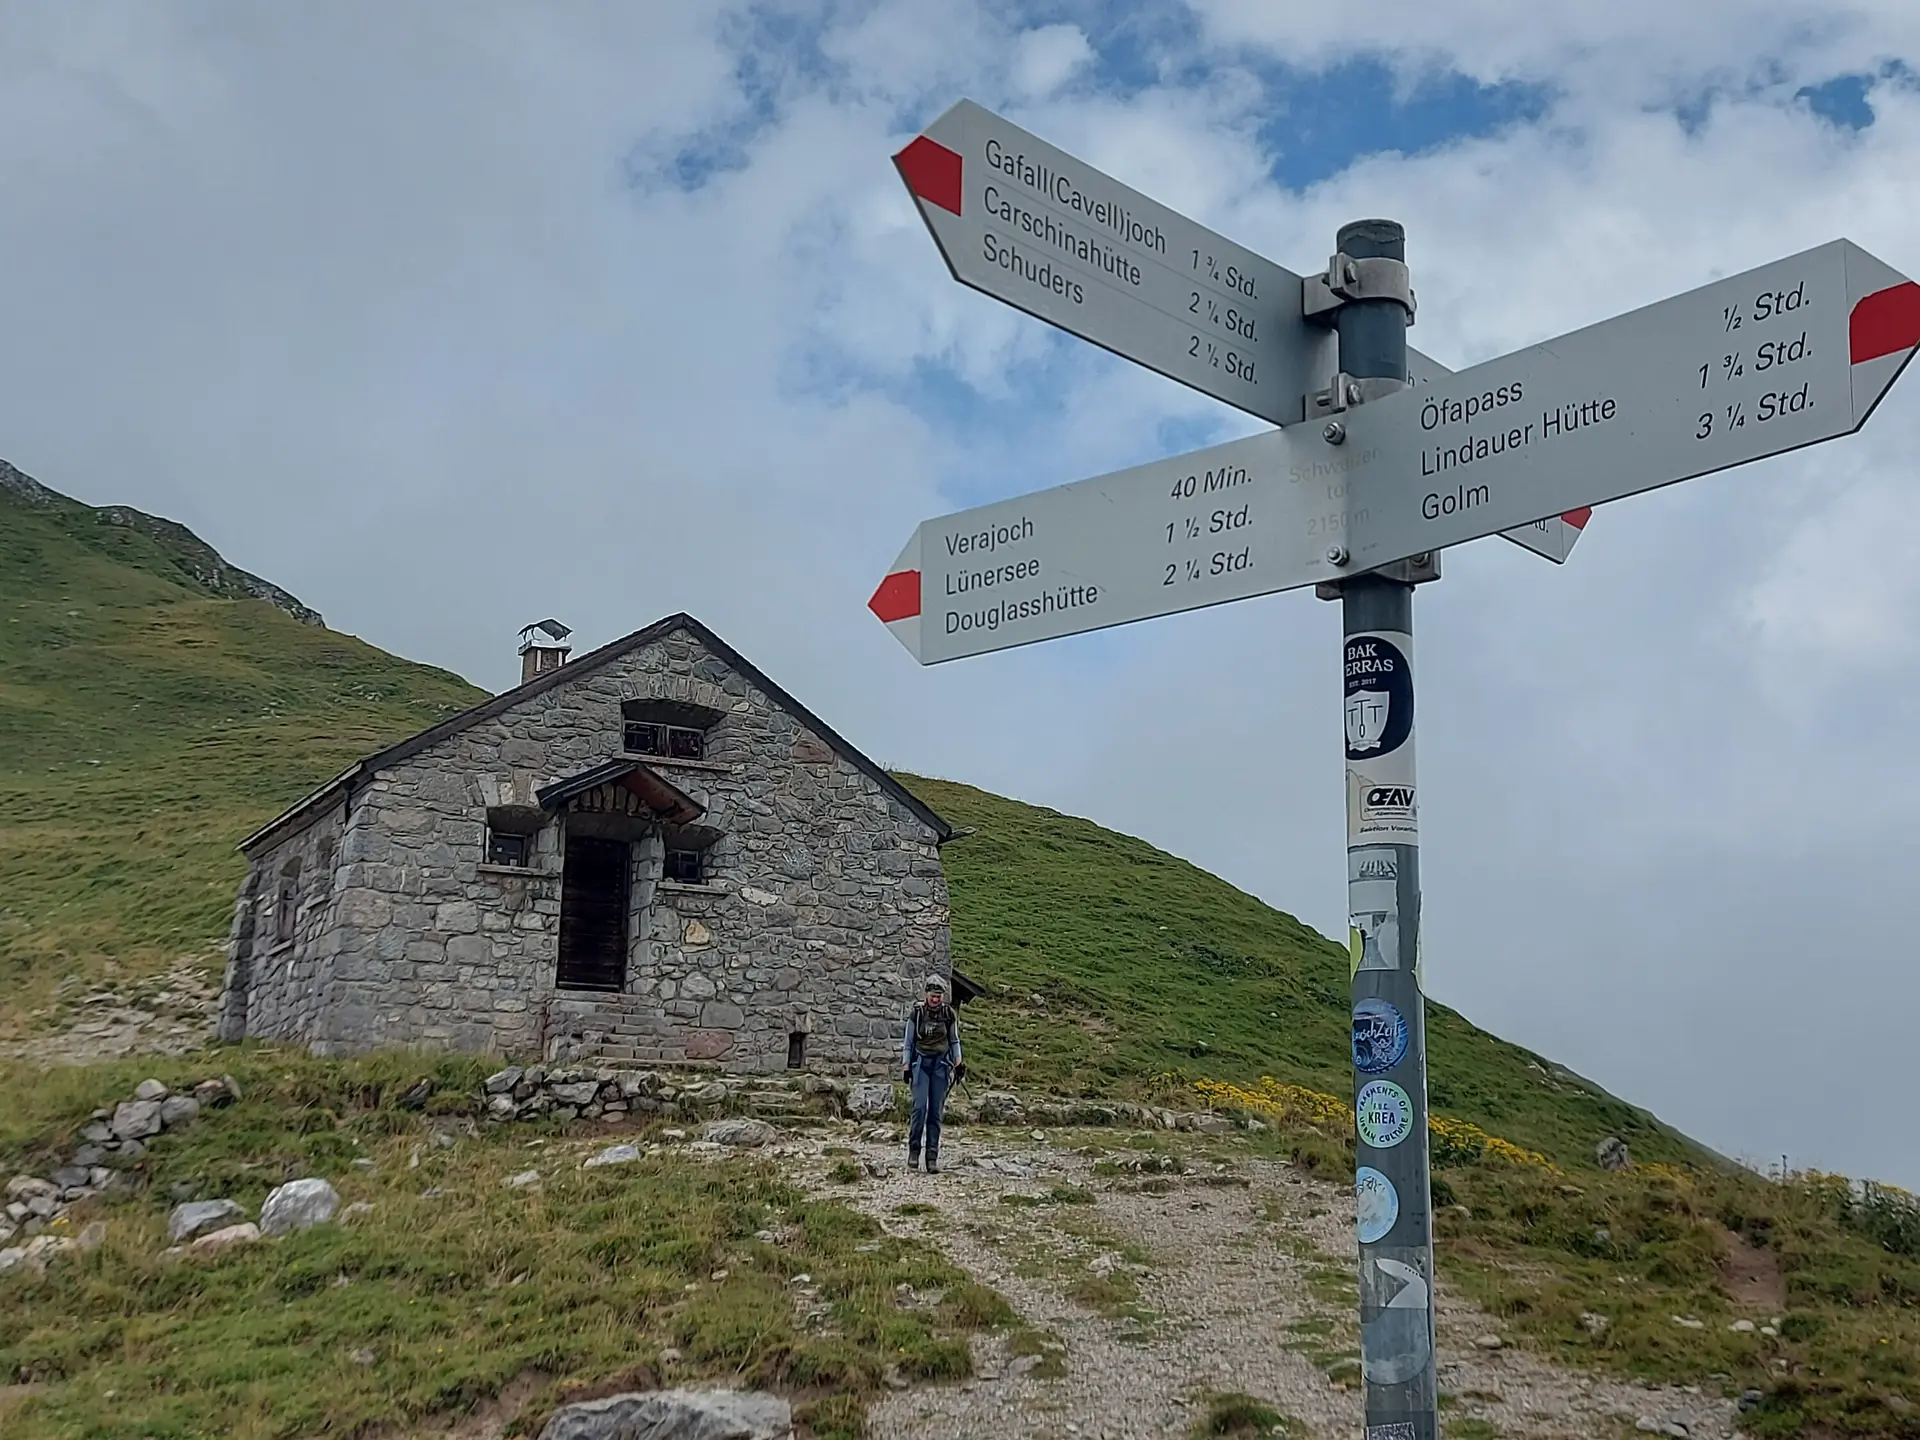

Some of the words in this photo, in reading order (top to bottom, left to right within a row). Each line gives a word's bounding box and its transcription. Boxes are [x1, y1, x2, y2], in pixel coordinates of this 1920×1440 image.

[984, 186, 1141, 286] Carschinahütte
[1189, 291, 1200, 314] 2
[1225, 309, 1258, 342] Std.
[985, 139, 1166, 254] Gafall(Cavell)joch
[1192, 249, 1199, 270] 1
[1225, 266, 1258, 300] Std.
[983, 233, 1084, 304] Schuders
[1188, 335, 1200, 357] 2
[1225, 352, 1258, 385] Std.
[1421, 382, 1523, 431] Öfapass
[1753, 281, 1810, 321] Std.
[1421, 424, 1534, 476] Lindauer
[1543, 398, 1616, 438] Hütte
[1699, 363, 1709, 389] 1
[1755, 331, 1812, 371] Std.
[1421, 484, 1489, 520] Golm
[1695, 412, 1713, 439] 3
[1757, 382, 1814, 421] Std.
[945, 516, 1033, 556] Verajoch
[1170, 476, 1196, 500] 40
[1203, 465, 1252, 493] Min.
[946, 559, 1040, 595] Lünersee
[1166, 522, 1174, 543] 1
[1209, 504, 1253, 533] Std.
[1307, 511, 1348, 536] 2150
[946, 585, 1098, 634] Douglasshütte
[1163, 563, 1176, 586] 2
[1210, 546, 1253, 575] Std.
[1345, 658, 1394, 677] ERRAS
[1347, 643, 1378, 660] BAK
[1368, 1111, 1396, 1125] KREA
[1379, 1117, 1409, 1143] CULTURE
[1399, 1100, 1409, 1113] OF
